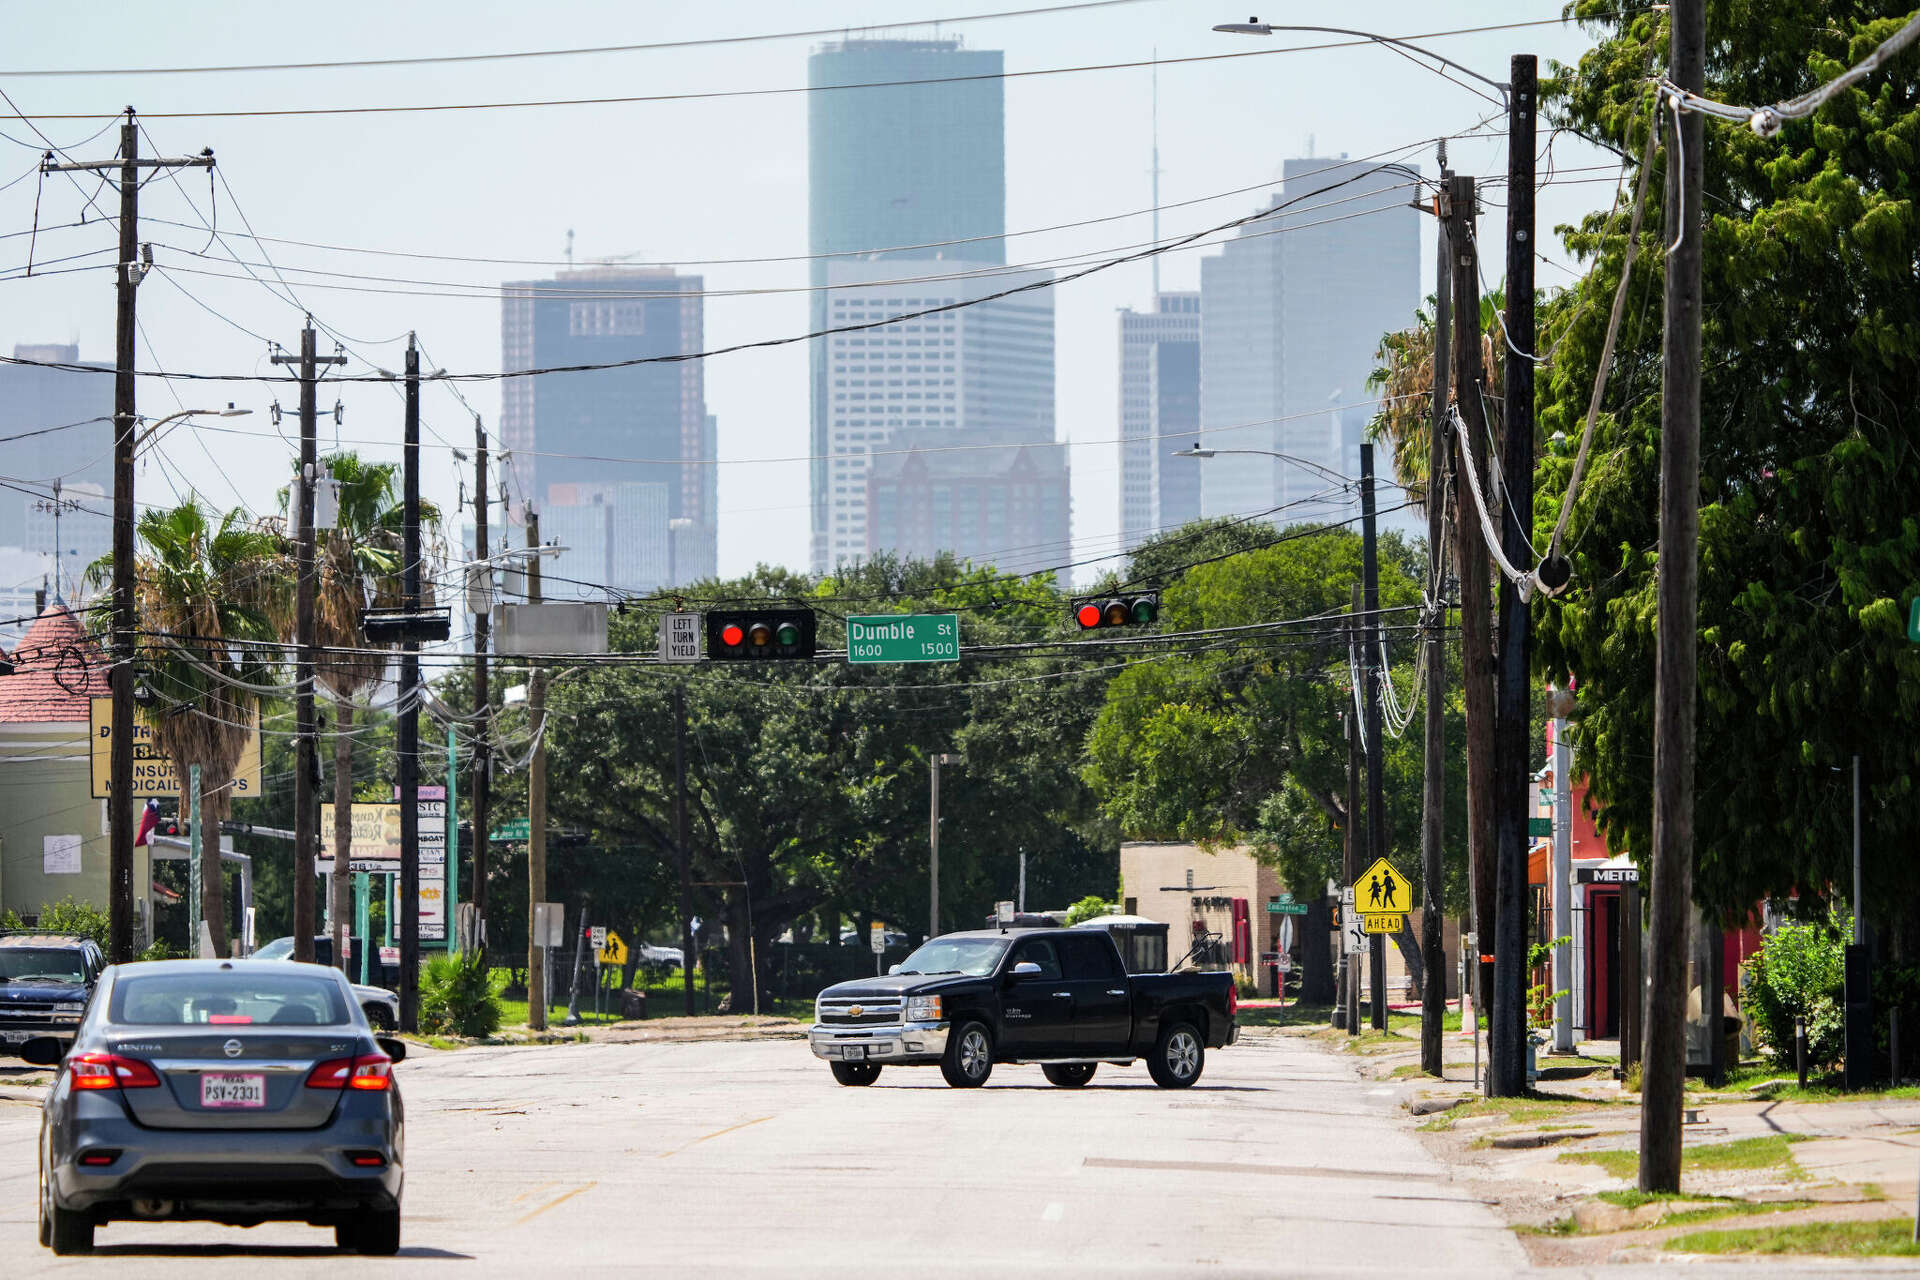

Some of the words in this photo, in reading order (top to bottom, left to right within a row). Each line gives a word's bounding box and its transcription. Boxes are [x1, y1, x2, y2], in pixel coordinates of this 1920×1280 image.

[673, 618, 691, 630] LEFT
[672, 631, 694, 643] TURN
[852, 622, 915, 640] Dumble
[937, 623, 951, 636] St
[671, 644, 696, 657] YIELD
[854, 644, 882, 657] 1600
[921, 642, 953, 655] 1500
[1367, 917, 1400, 929] AHEAD
